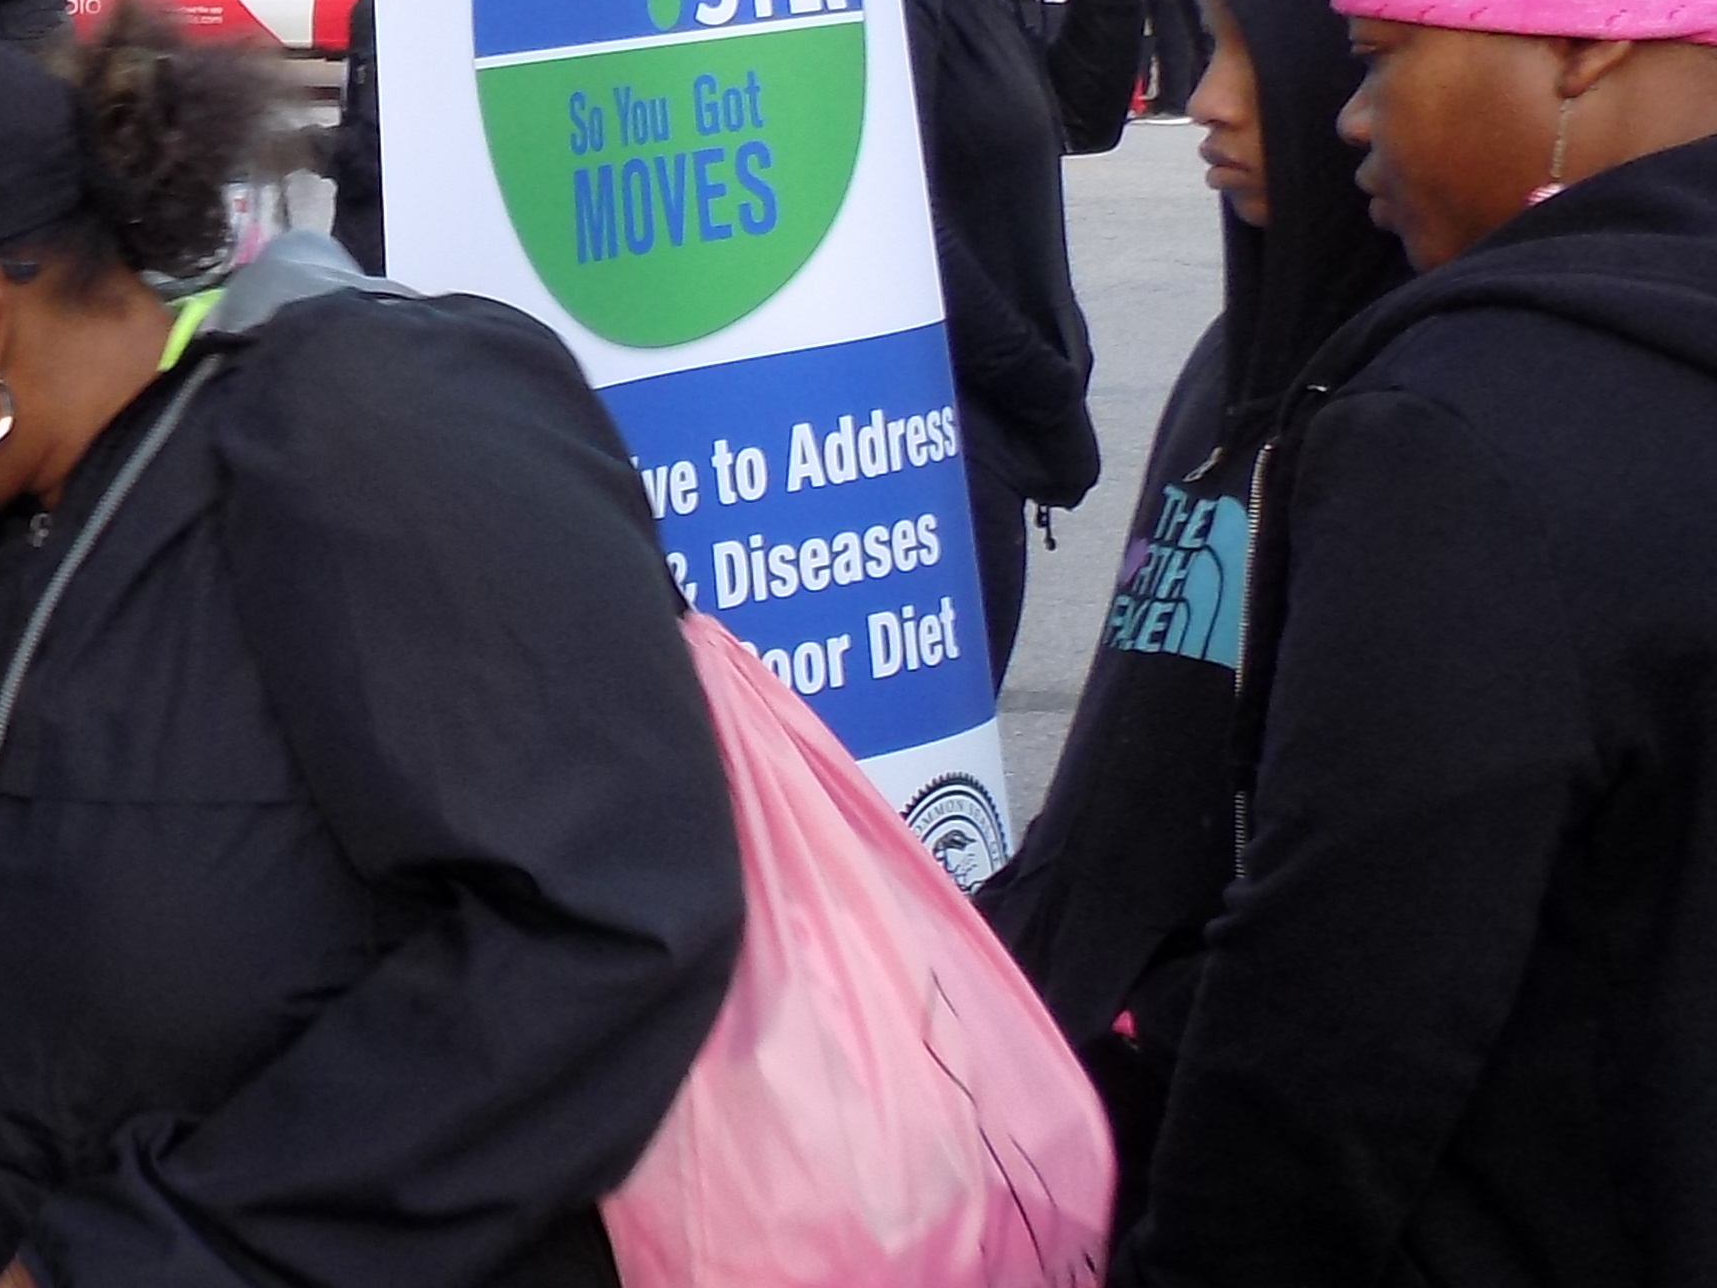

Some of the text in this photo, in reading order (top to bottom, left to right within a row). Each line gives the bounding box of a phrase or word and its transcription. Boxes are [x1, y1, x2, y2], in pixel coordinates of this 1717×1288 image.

[569, 70, 764, 156] So You Got
[573, 142, 778, 265] MOVES
[712, 404, 958, 506] to Address
[714, 512, 943, 610] Diseases
[867, 595, 962, 680] Diet
